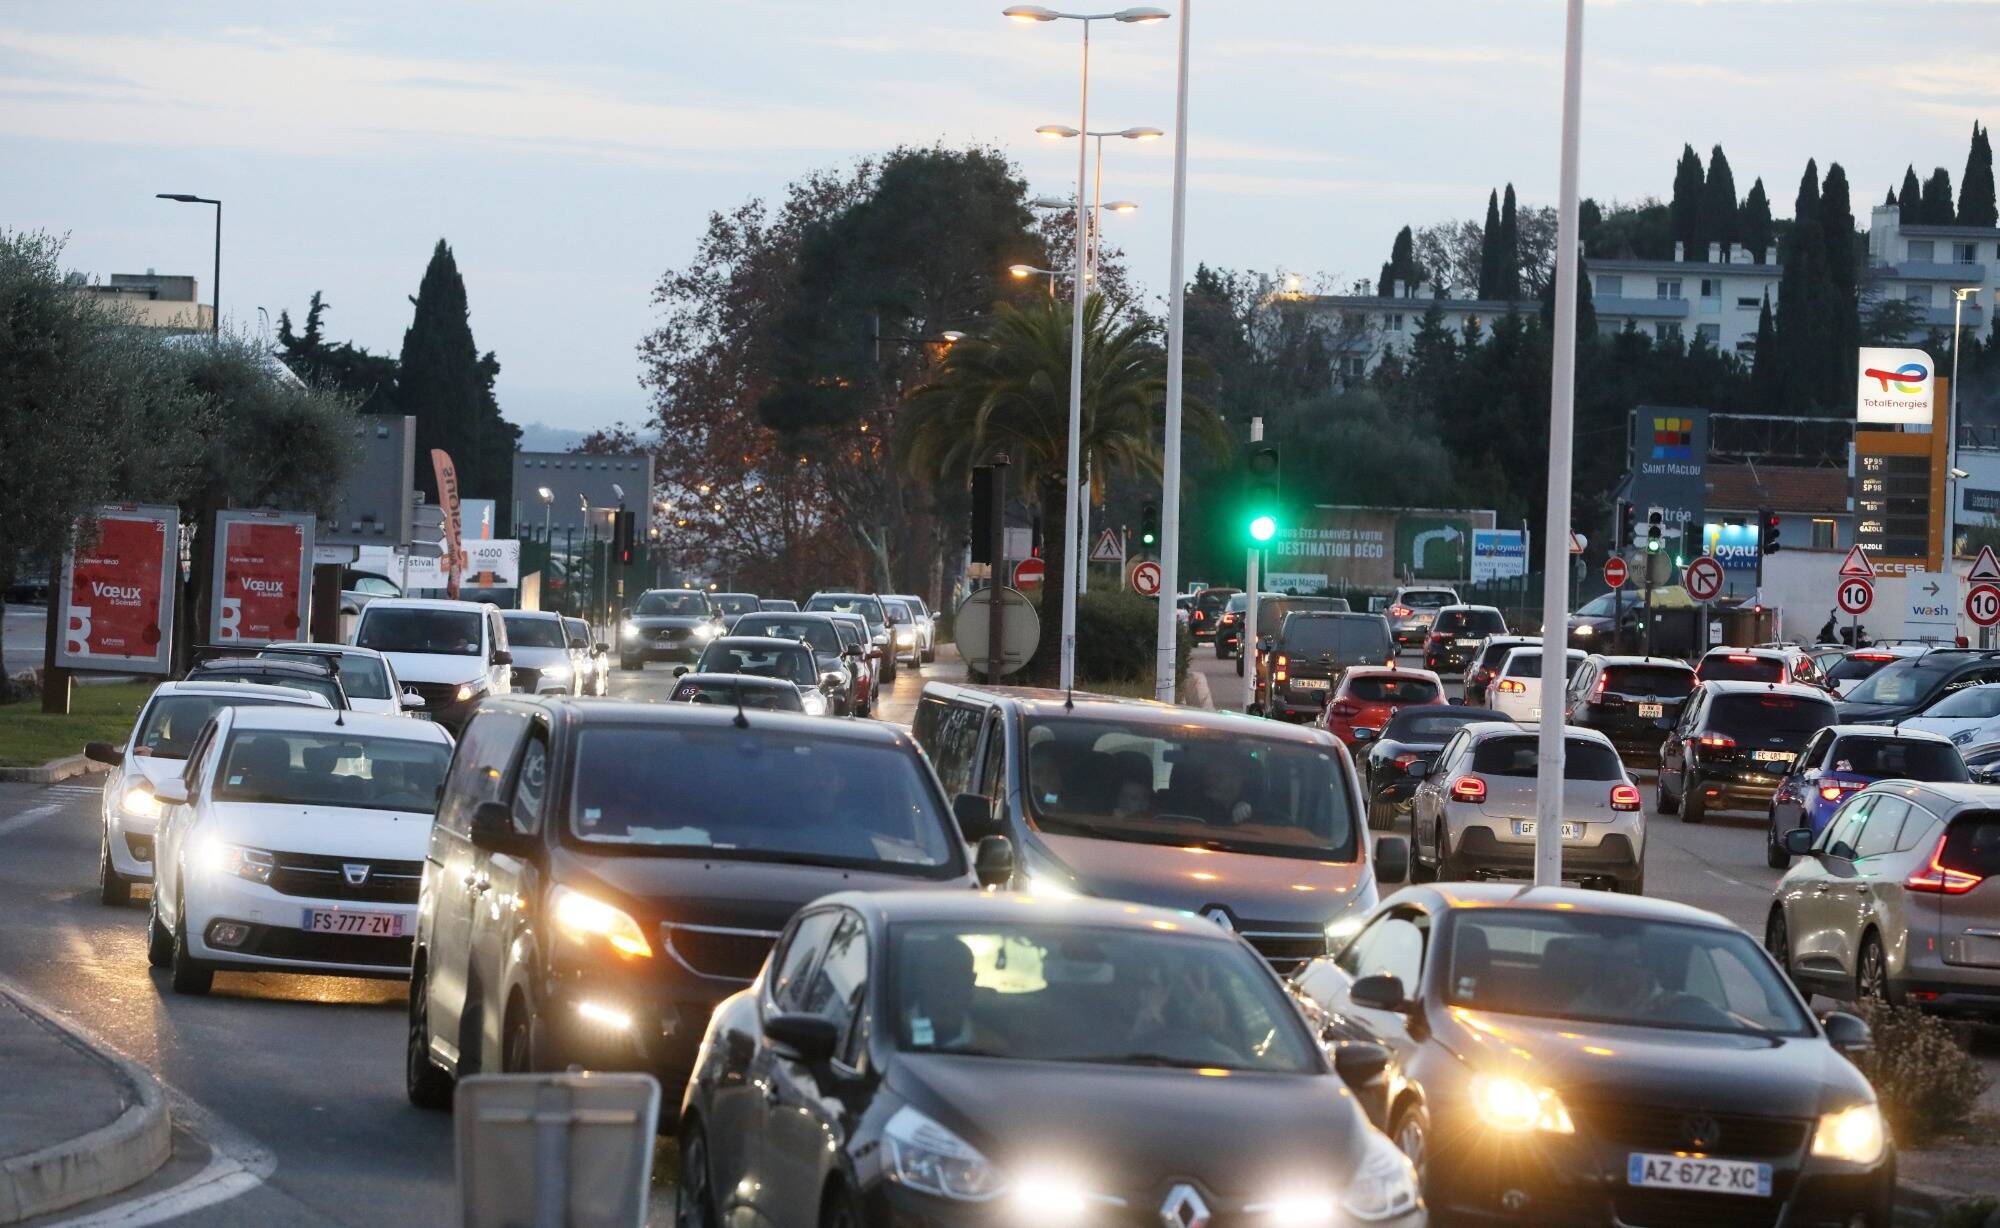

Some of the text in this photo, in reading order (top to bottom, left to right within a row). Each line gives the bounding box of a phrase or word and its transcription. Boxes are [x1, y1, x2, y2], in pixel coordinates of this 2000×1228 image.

[1864, 398, 1928, 410] TotalEnergies
[1642, 462, 1701, 476] SAINT MACLOU
[1360, 530, 1383, 541] VOTRE
[1859, 525, 1884, 533] GAZOLE
[1277, 541, 1384, 558] DESTINATION DÉCO
[398, 557, 435, 567] Fstival
[92, 581, 142, 600] Vœux
[241, 577, 284, 592] Vœux
[1844, 586, 1867, 605] 10
[1913, 604, 1949, 616] wash
[1973, 594, 1998, 615] 10
[313, 912, 391, 934] FS-777-ZV
[1645, 1160, 1756, 1190] AZ-672-XC
